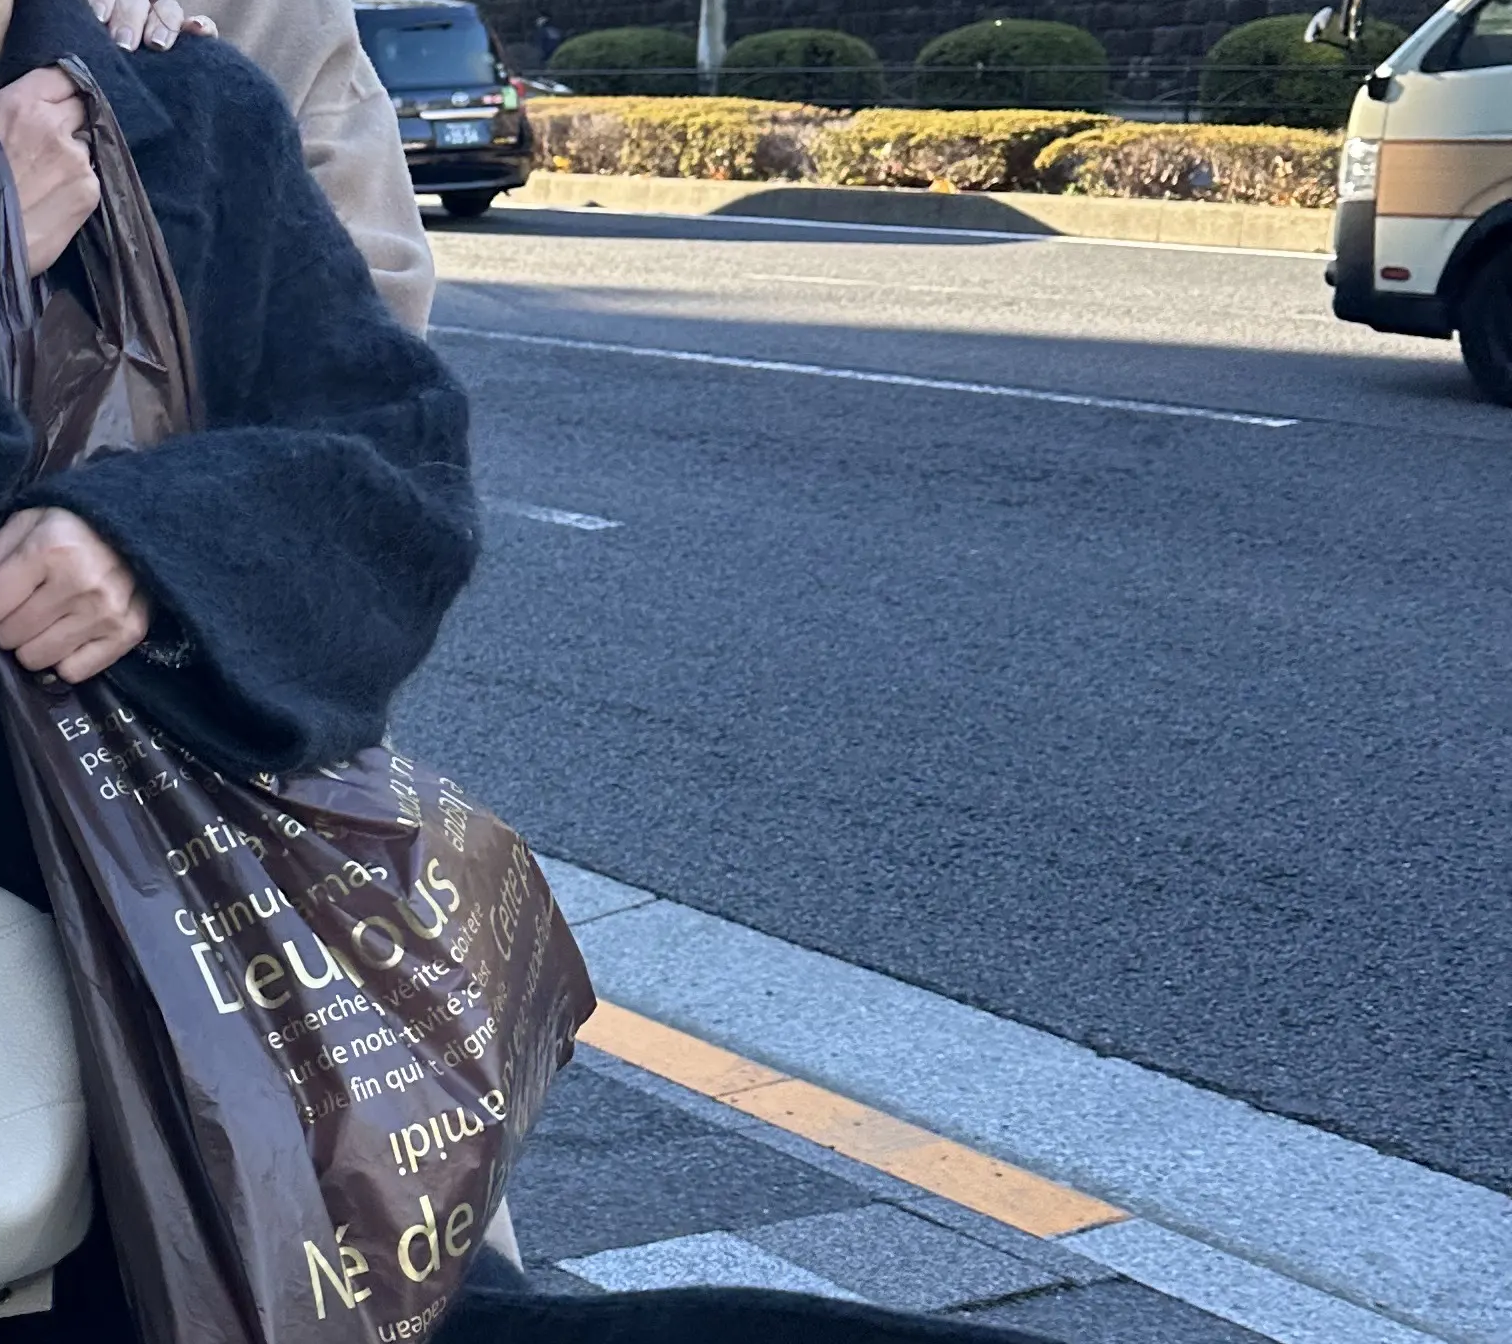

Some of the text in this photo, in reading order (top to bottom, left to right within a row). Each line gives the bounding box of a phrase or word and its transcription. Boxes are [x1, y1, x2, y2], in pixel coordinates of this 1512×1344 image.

[349, 1075, 383, 1103] fin
[384, 1056, 426, 1094] qui
[302, 1194, 475, 1321] Né de
